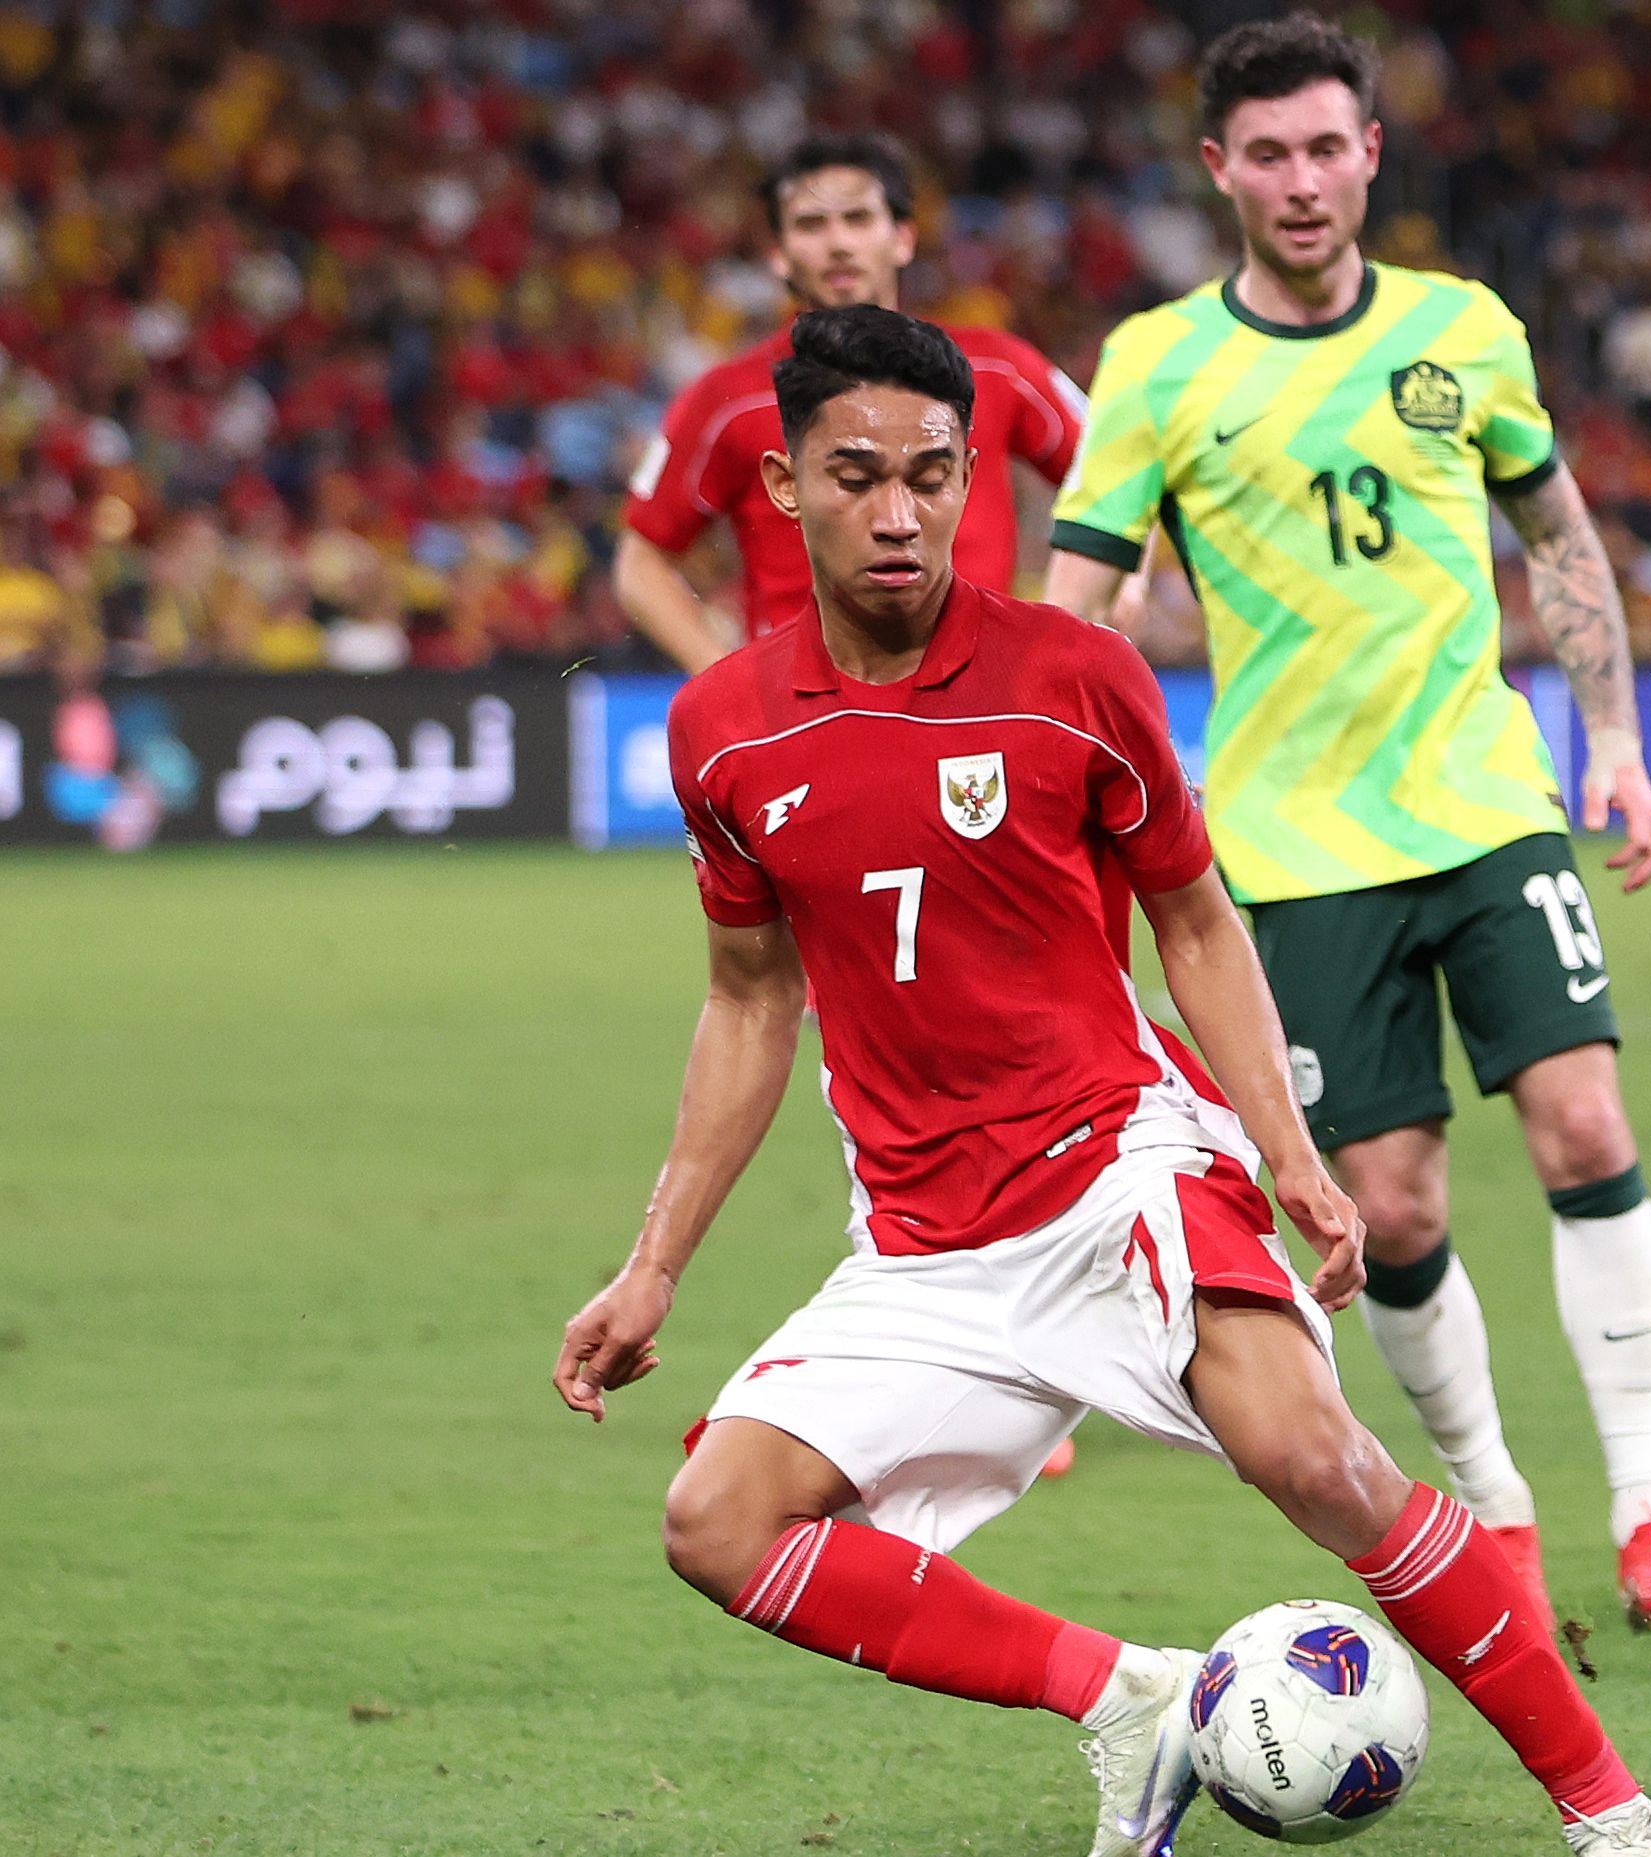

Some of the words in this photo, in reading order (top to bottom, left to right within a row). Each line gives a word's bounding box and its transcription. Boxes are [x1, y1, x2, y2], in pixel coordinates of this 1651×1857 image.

[1309, 465, 1395, 566] 13
[215, 695, 516, 836] نيوم
[861, 867, 925, 982] 7
[1522, 869, 1604, 971] 13
[1251, 1698, 1292, 1791] molten
